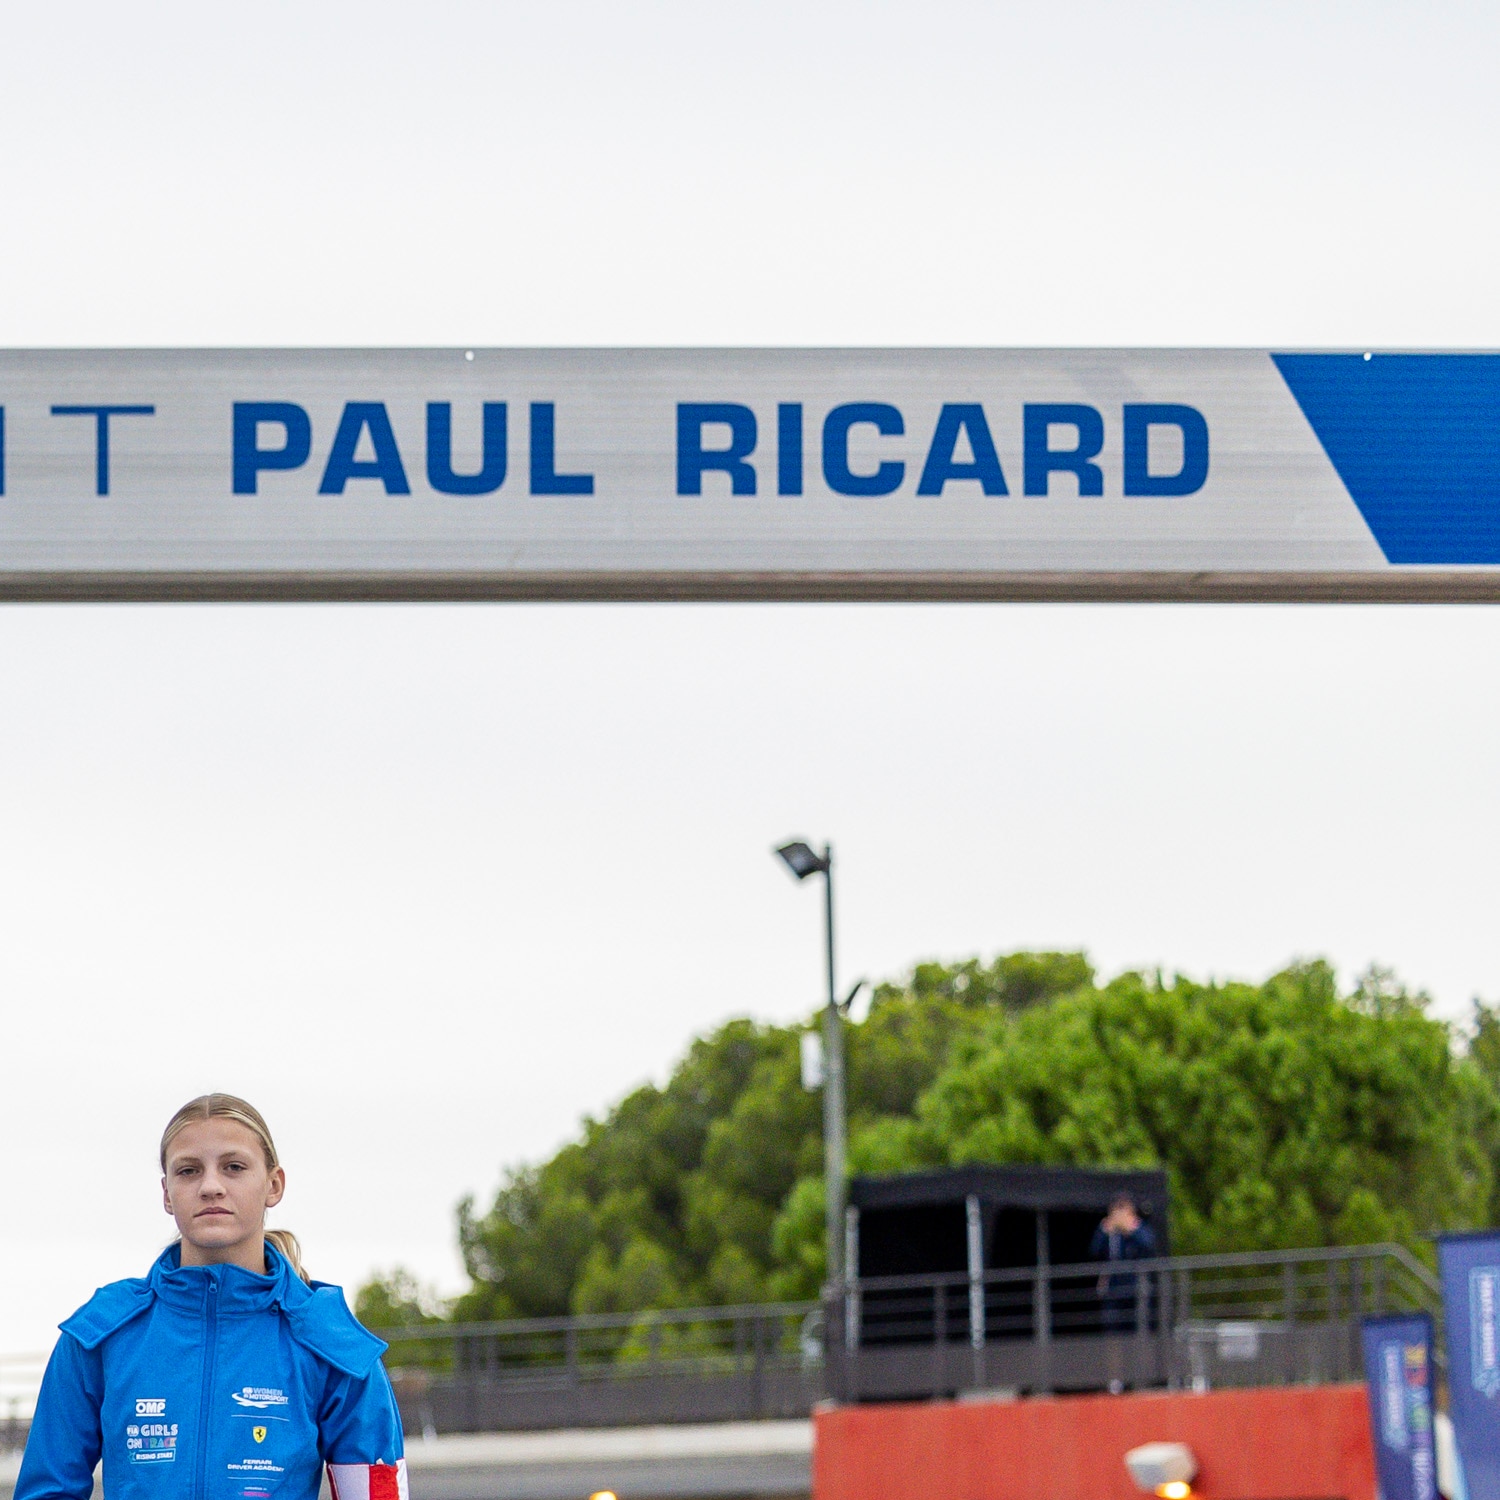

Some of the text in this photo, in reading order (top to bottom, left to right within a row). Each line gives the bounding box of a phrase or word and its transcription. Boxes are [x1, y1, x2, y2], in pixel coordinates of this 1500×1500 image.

[232, 401, 594, 495] PAUL
[676, 402, 1209, 496] RICARD
[135, 1402, 166, 1414] OMP
[141, 1424, 178, 1437] GIRLS
[127, 1438, 142, 1449] ON
